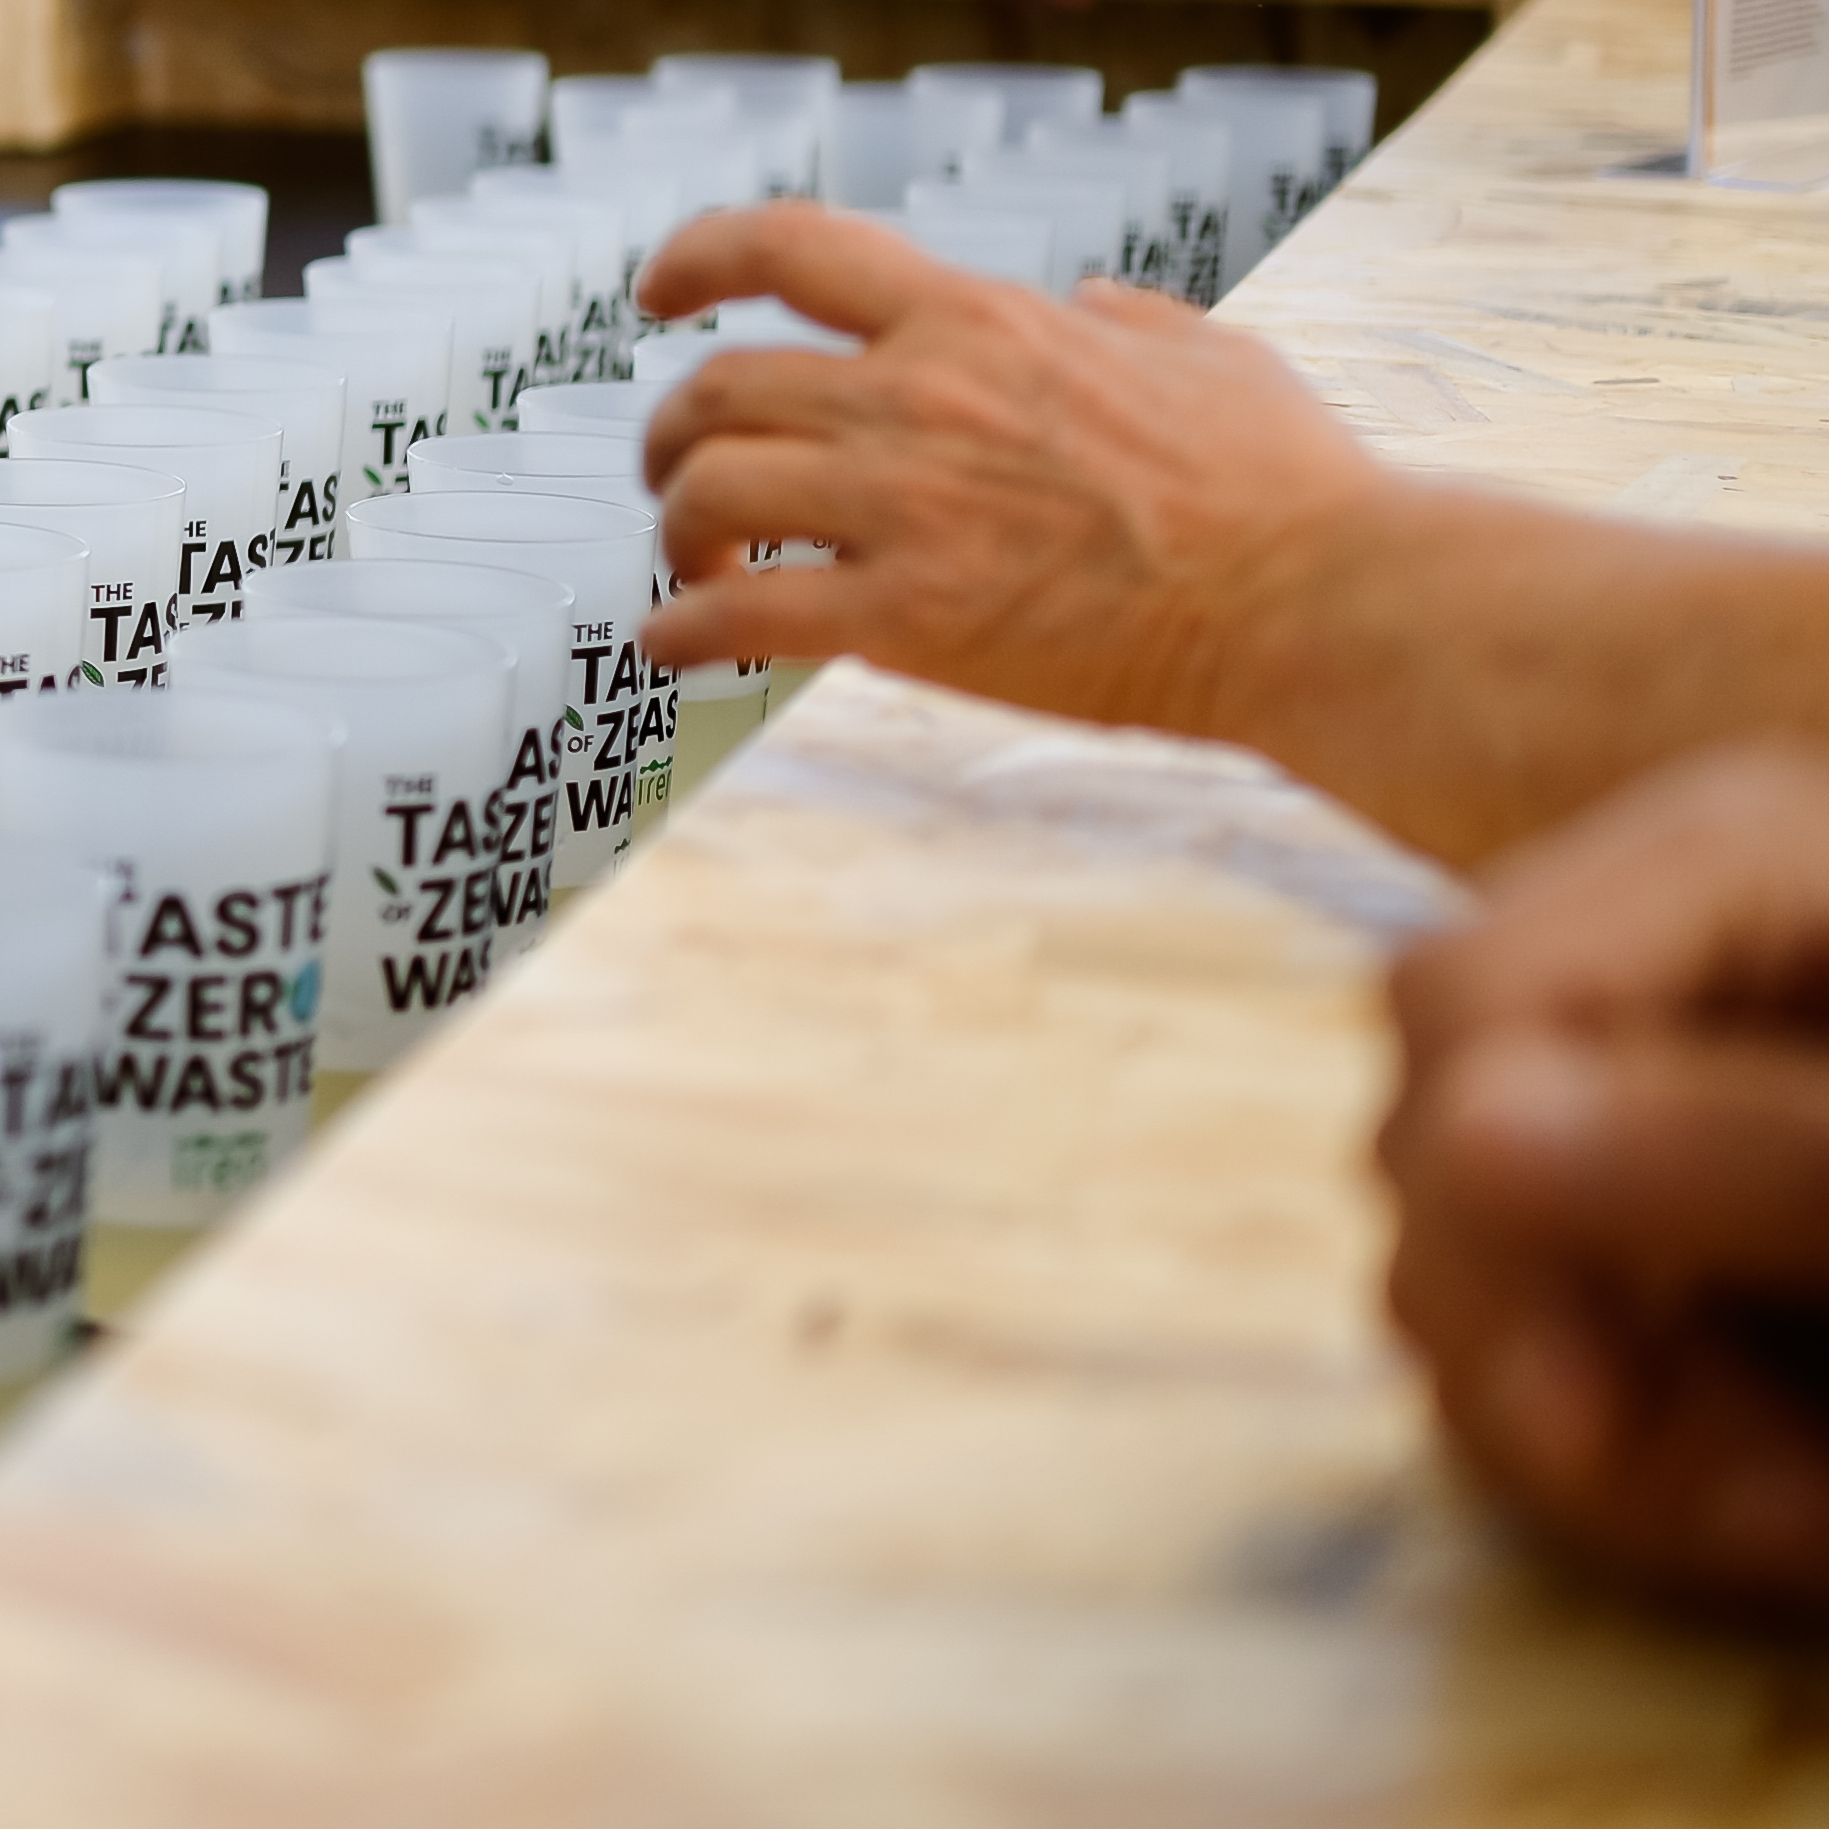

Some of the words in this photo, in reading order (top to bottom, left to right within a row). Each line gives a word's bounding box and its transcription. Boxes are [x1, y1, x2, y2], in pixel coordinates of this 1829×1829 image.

[91, 582, 133, 603] THE
[572, 621, 614, 643] THE
[567, 735, 594, 753] OF
